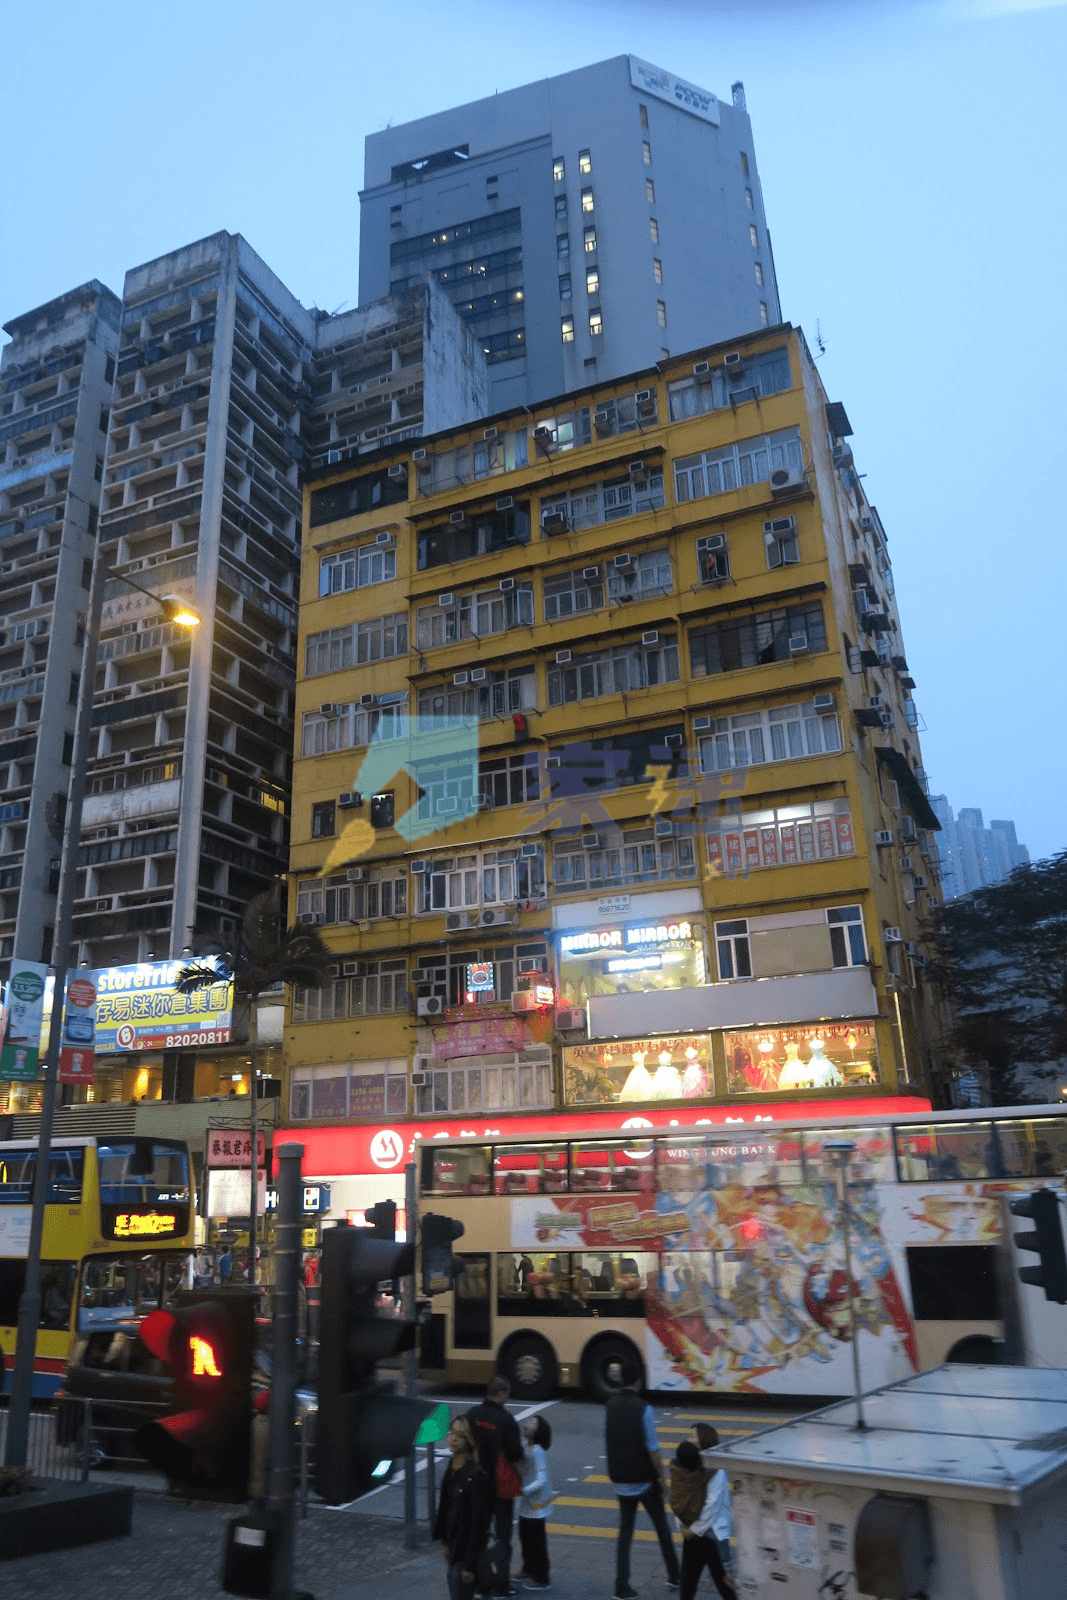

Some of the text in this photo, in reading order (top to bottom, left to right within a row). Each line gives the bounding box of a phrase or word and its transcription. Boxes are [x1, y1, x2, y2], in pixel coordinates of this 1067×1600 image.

[560, 921, 692, 951] MIRROR MIRROR
[95, 986, 229, 1024] 存易迷你倉集團
[166, 1030, 231, 1048] 82020811
